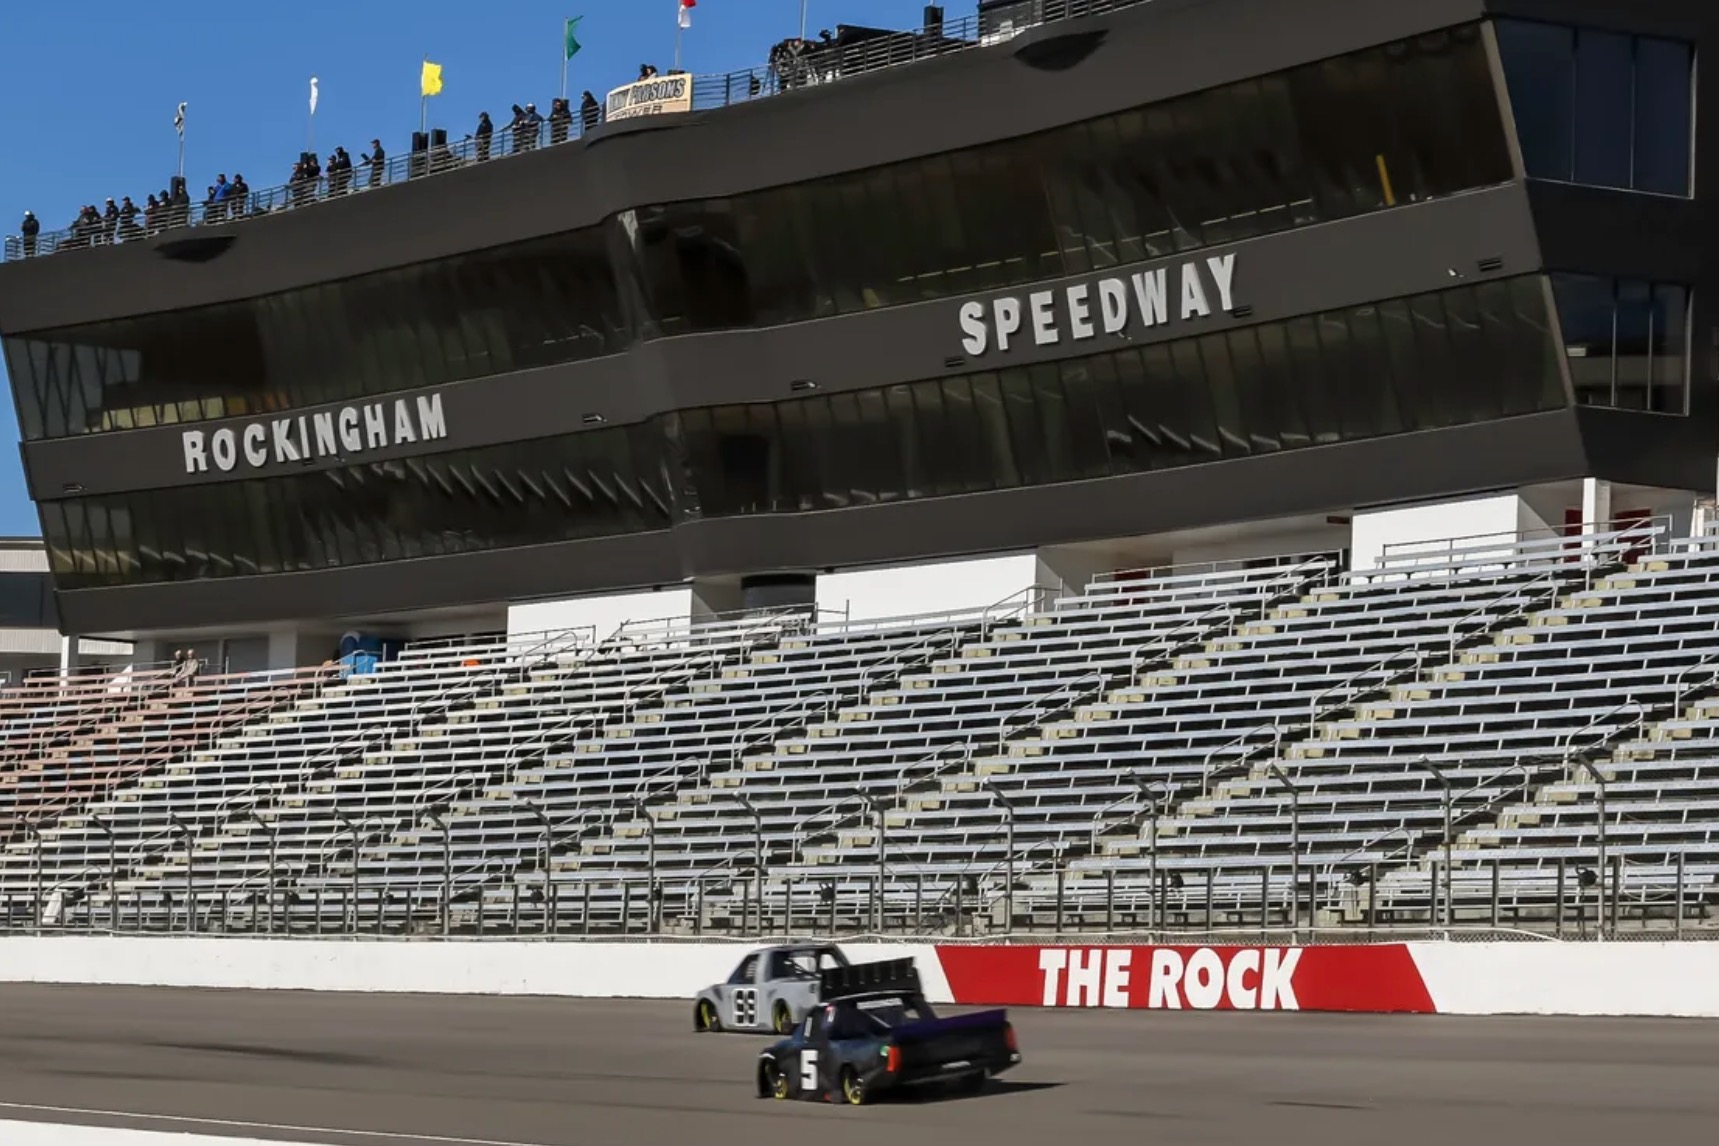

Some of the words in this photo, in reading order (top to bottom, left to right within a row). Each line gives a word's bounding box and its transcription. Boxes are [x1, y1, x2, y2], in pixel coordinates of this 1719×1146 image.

[960, 253, 1237, 357] SPEEDWAY
[182, 393, 448, 473] ROCKINGHAM
[1038, 948, 1131, 1008] THE
[1148, 947, 1304, 1011] ROCK
[800, 1049, 818, 1090] 5
